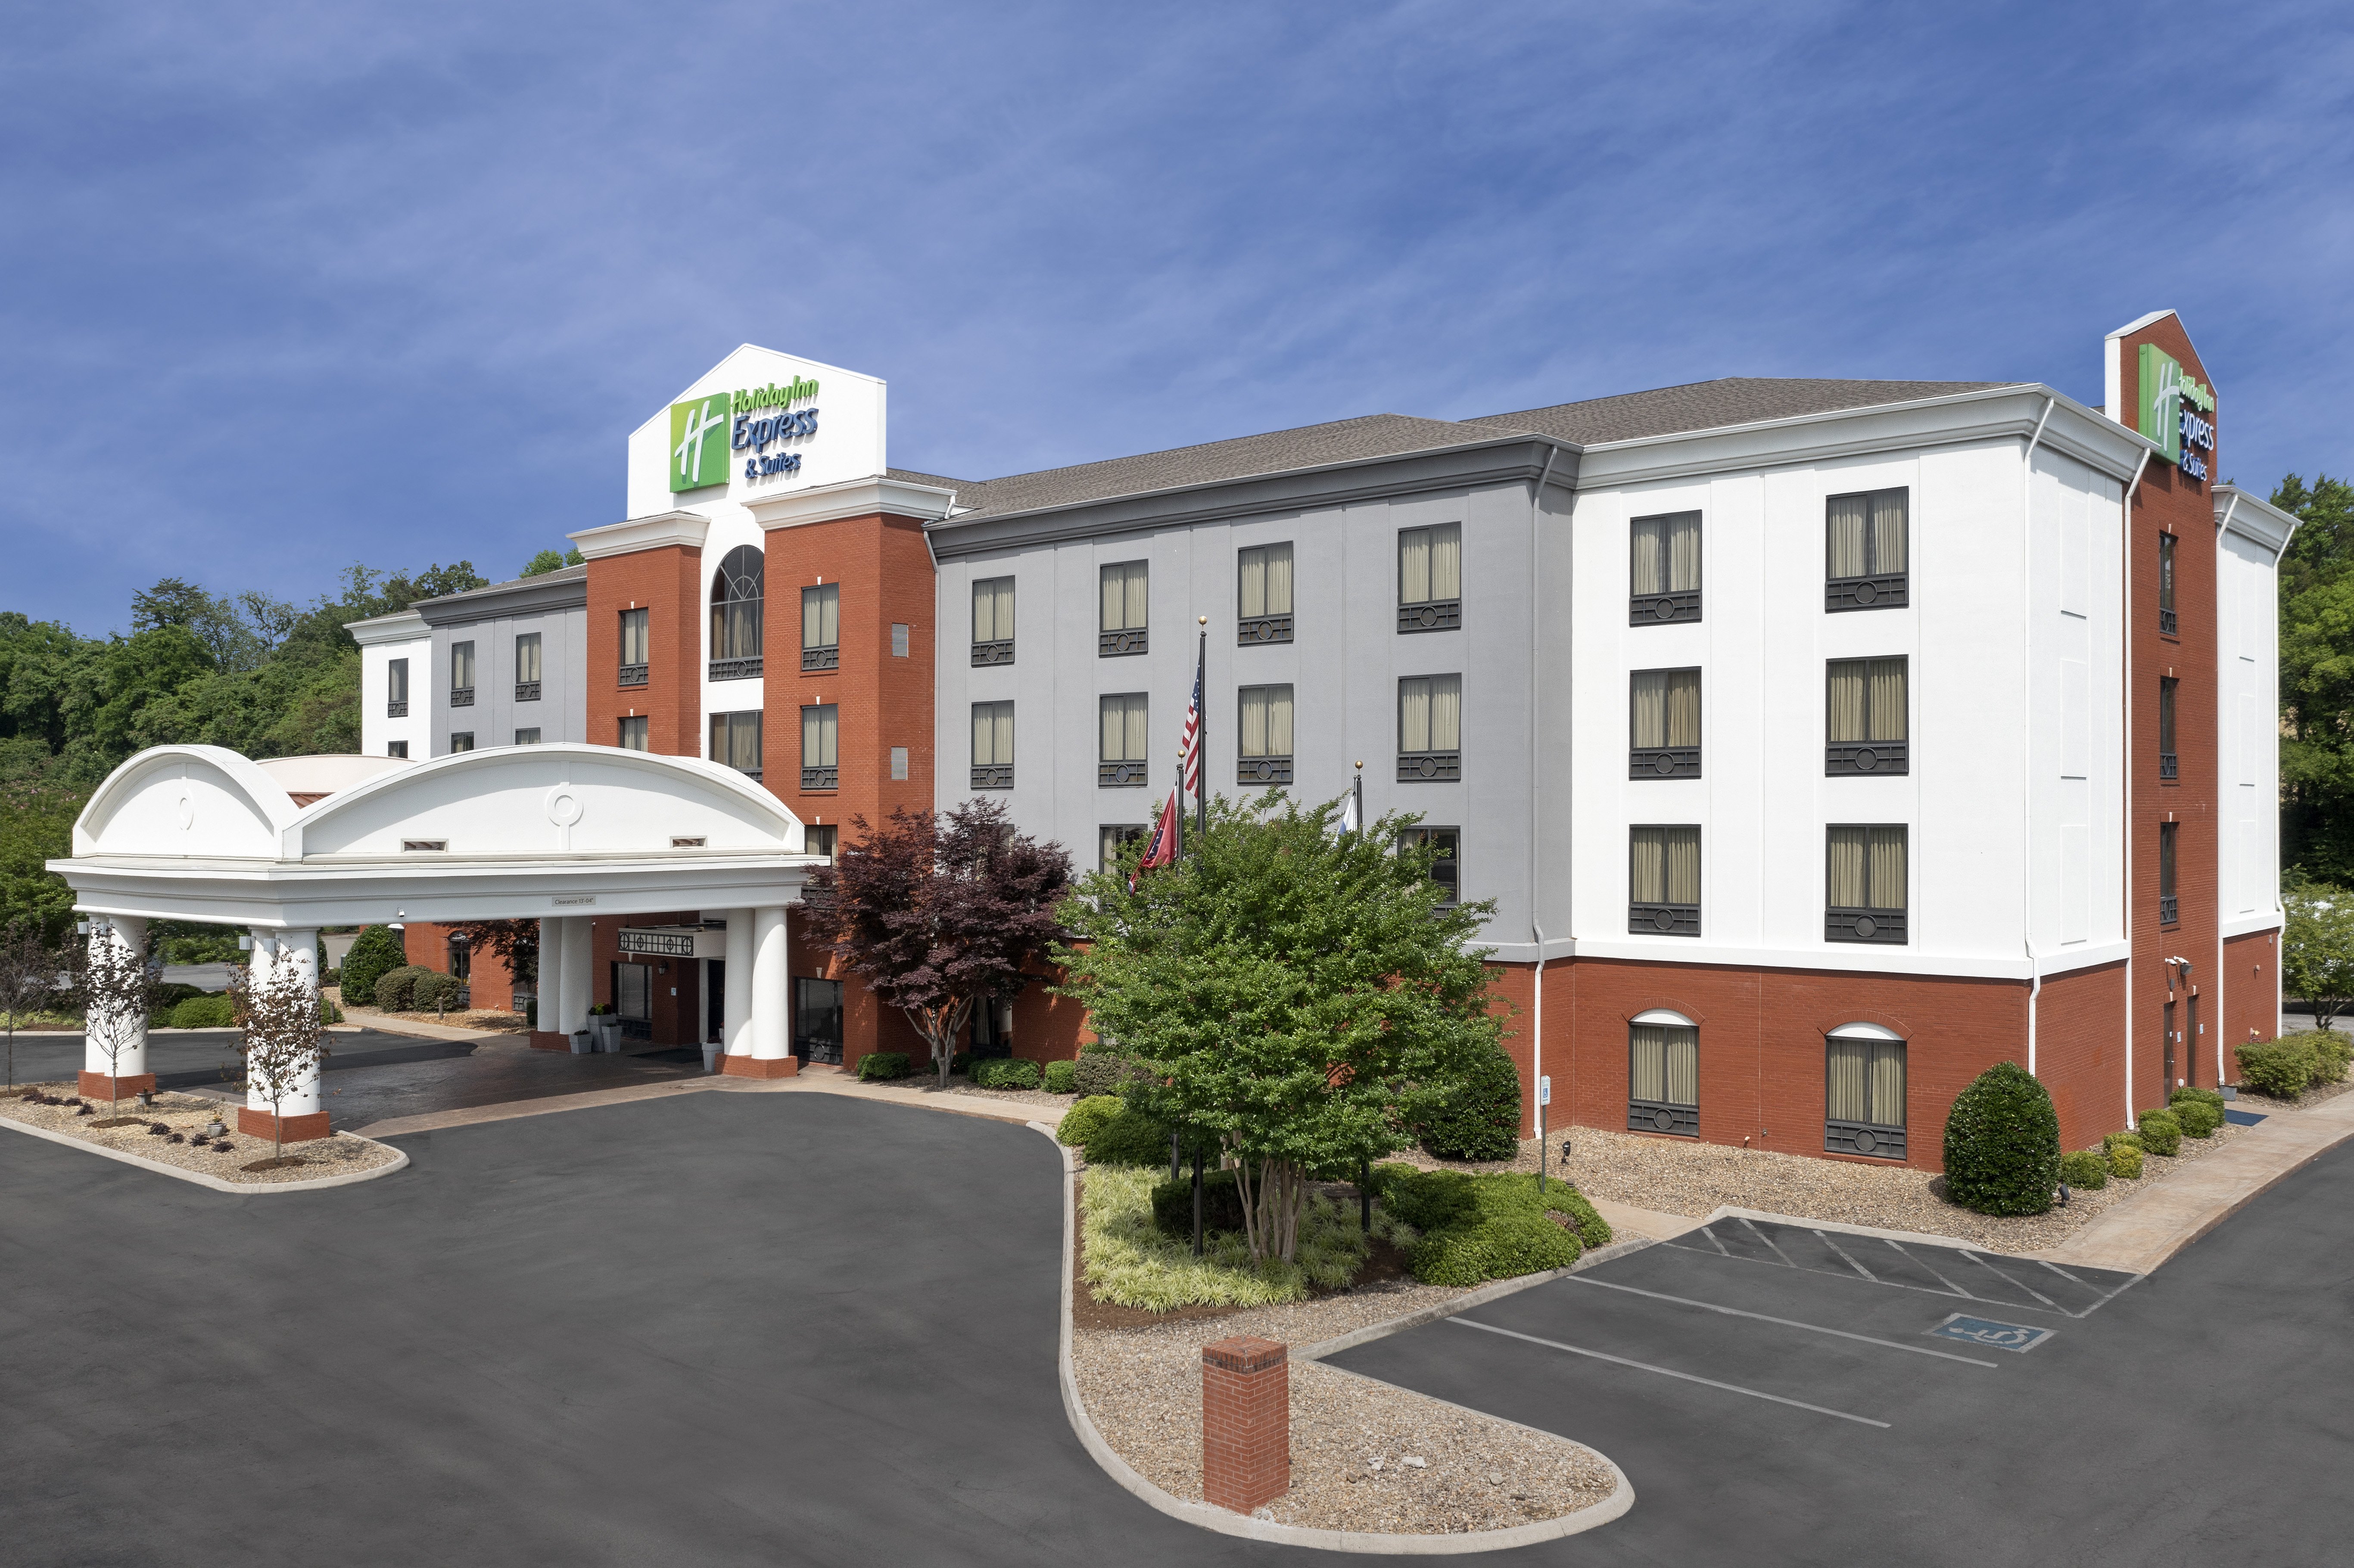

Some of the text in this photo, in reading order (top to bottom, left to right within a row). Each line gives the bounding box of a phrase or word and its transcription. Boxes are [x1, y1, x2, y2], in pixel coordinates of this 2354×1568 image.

[731, 375, 819, 414] Holiday Inn
[675, 400, 723, 482] H
[732, 408, 819, 454] Express
[745, 452, 802, 479] & Suites
[2188, 453, 2207, 481] Suites
